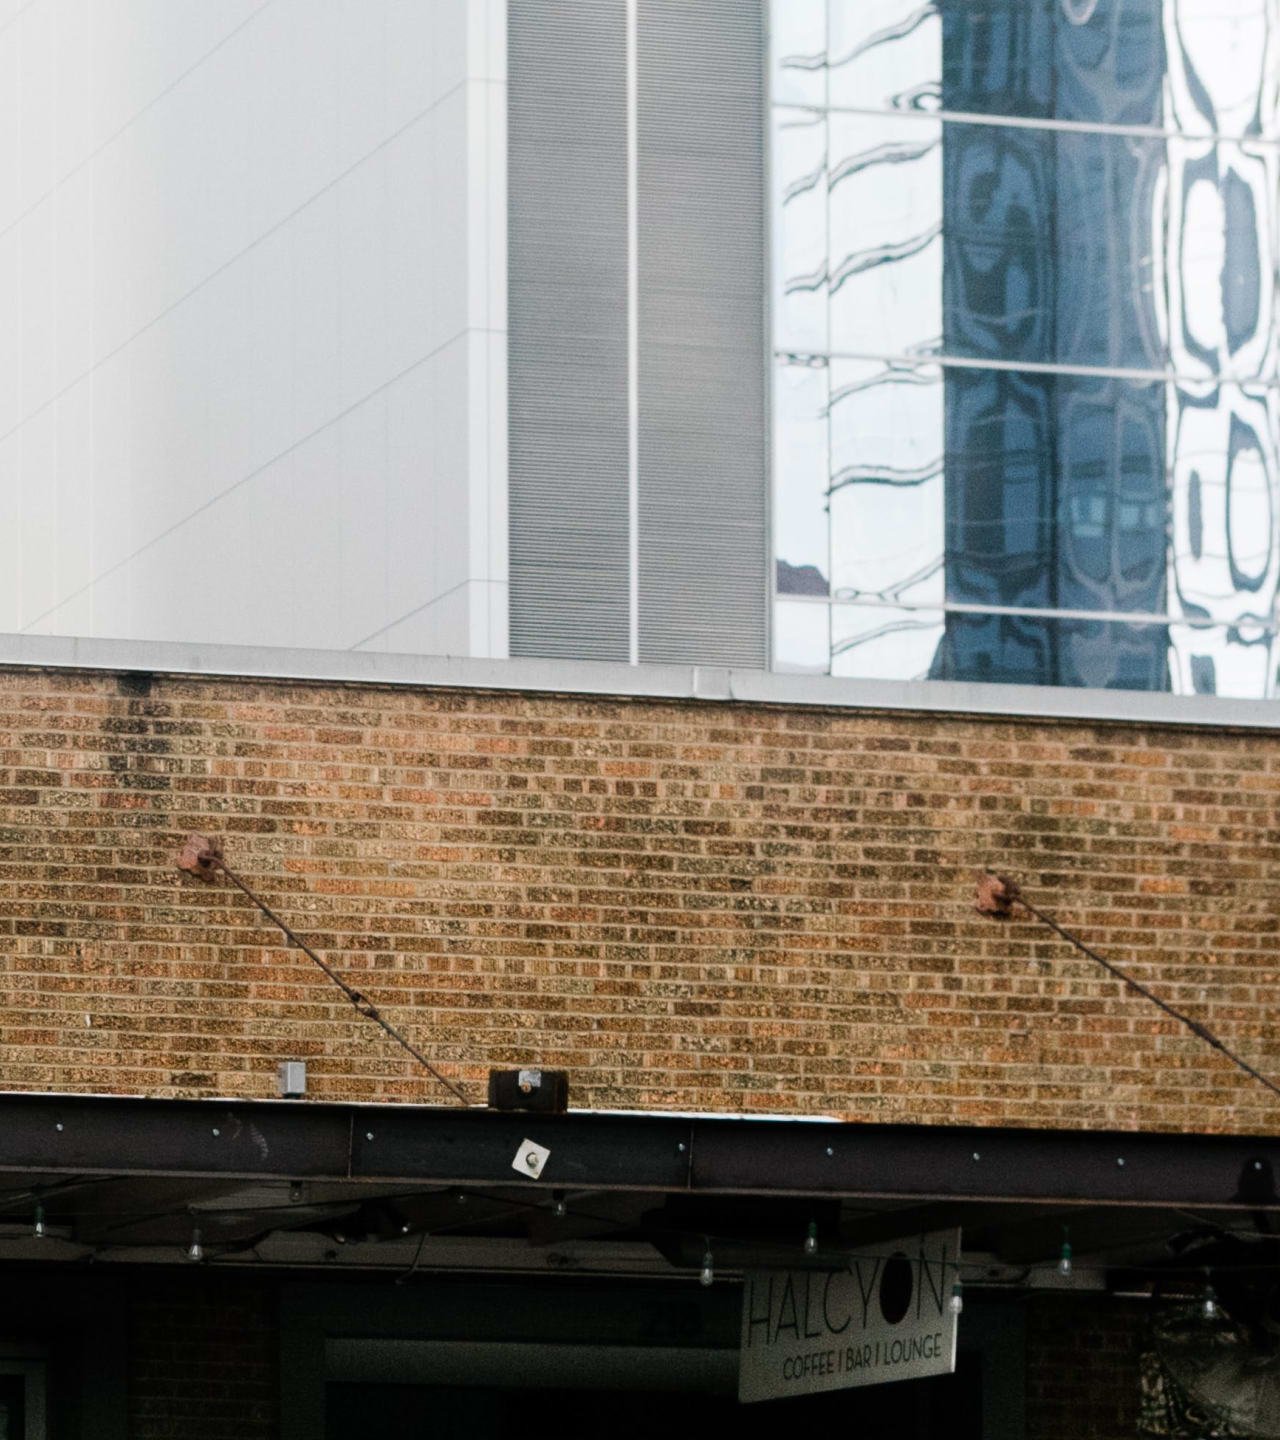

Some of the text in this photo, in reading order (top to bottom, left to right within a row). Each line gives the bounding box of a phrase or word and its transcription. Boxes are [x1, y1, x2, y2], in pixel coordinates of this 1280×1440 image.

[747, 1242, 947, 1348] HALCYON
[783, 1350, 835, 1380] COFFEE
[845, 1344, 871, 1372] BAR
[883, 1333, 942, 1366] LOUNGE
